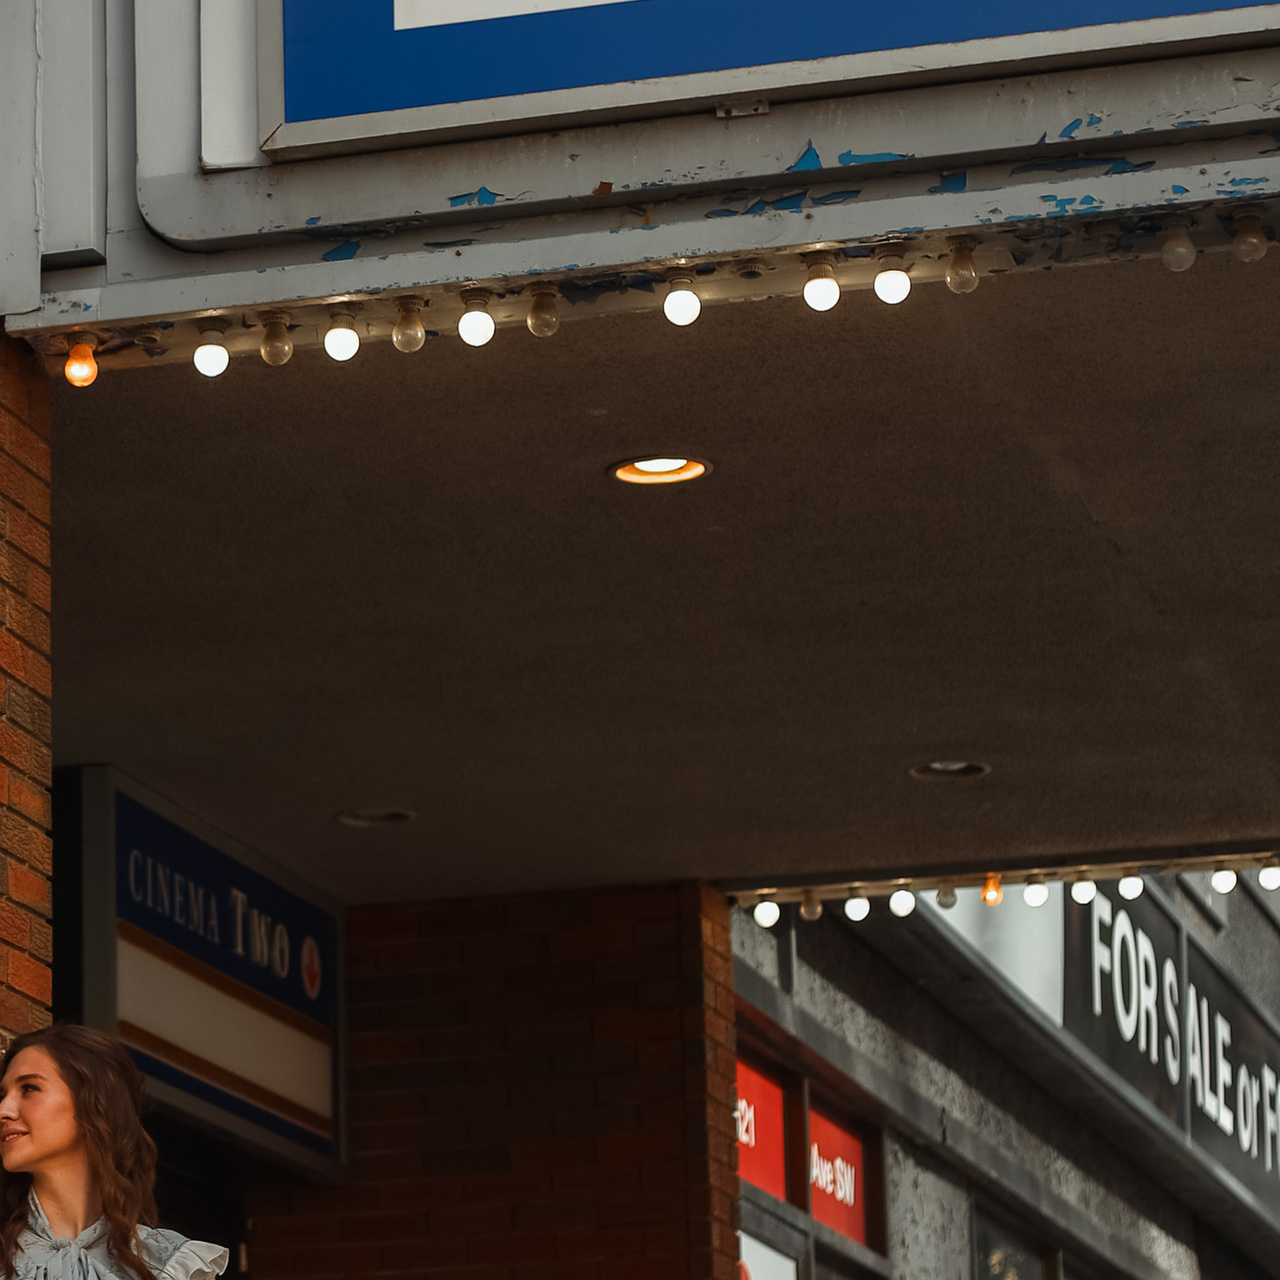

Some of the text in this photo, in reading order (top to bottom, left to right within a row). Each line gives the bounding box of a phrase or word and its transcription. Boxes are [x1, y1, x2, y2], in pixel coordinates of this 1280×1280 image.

[128, 849, 220, 945] CINEMA
[1091, 888, 1159, 1065] FOR
[1162, 957, 1234, 1137] SALE
[1236, 1062, 1261, 1160] or
[809, 1142, 834, 1195] Ave
[834, 1156, 856, 1208] SW
